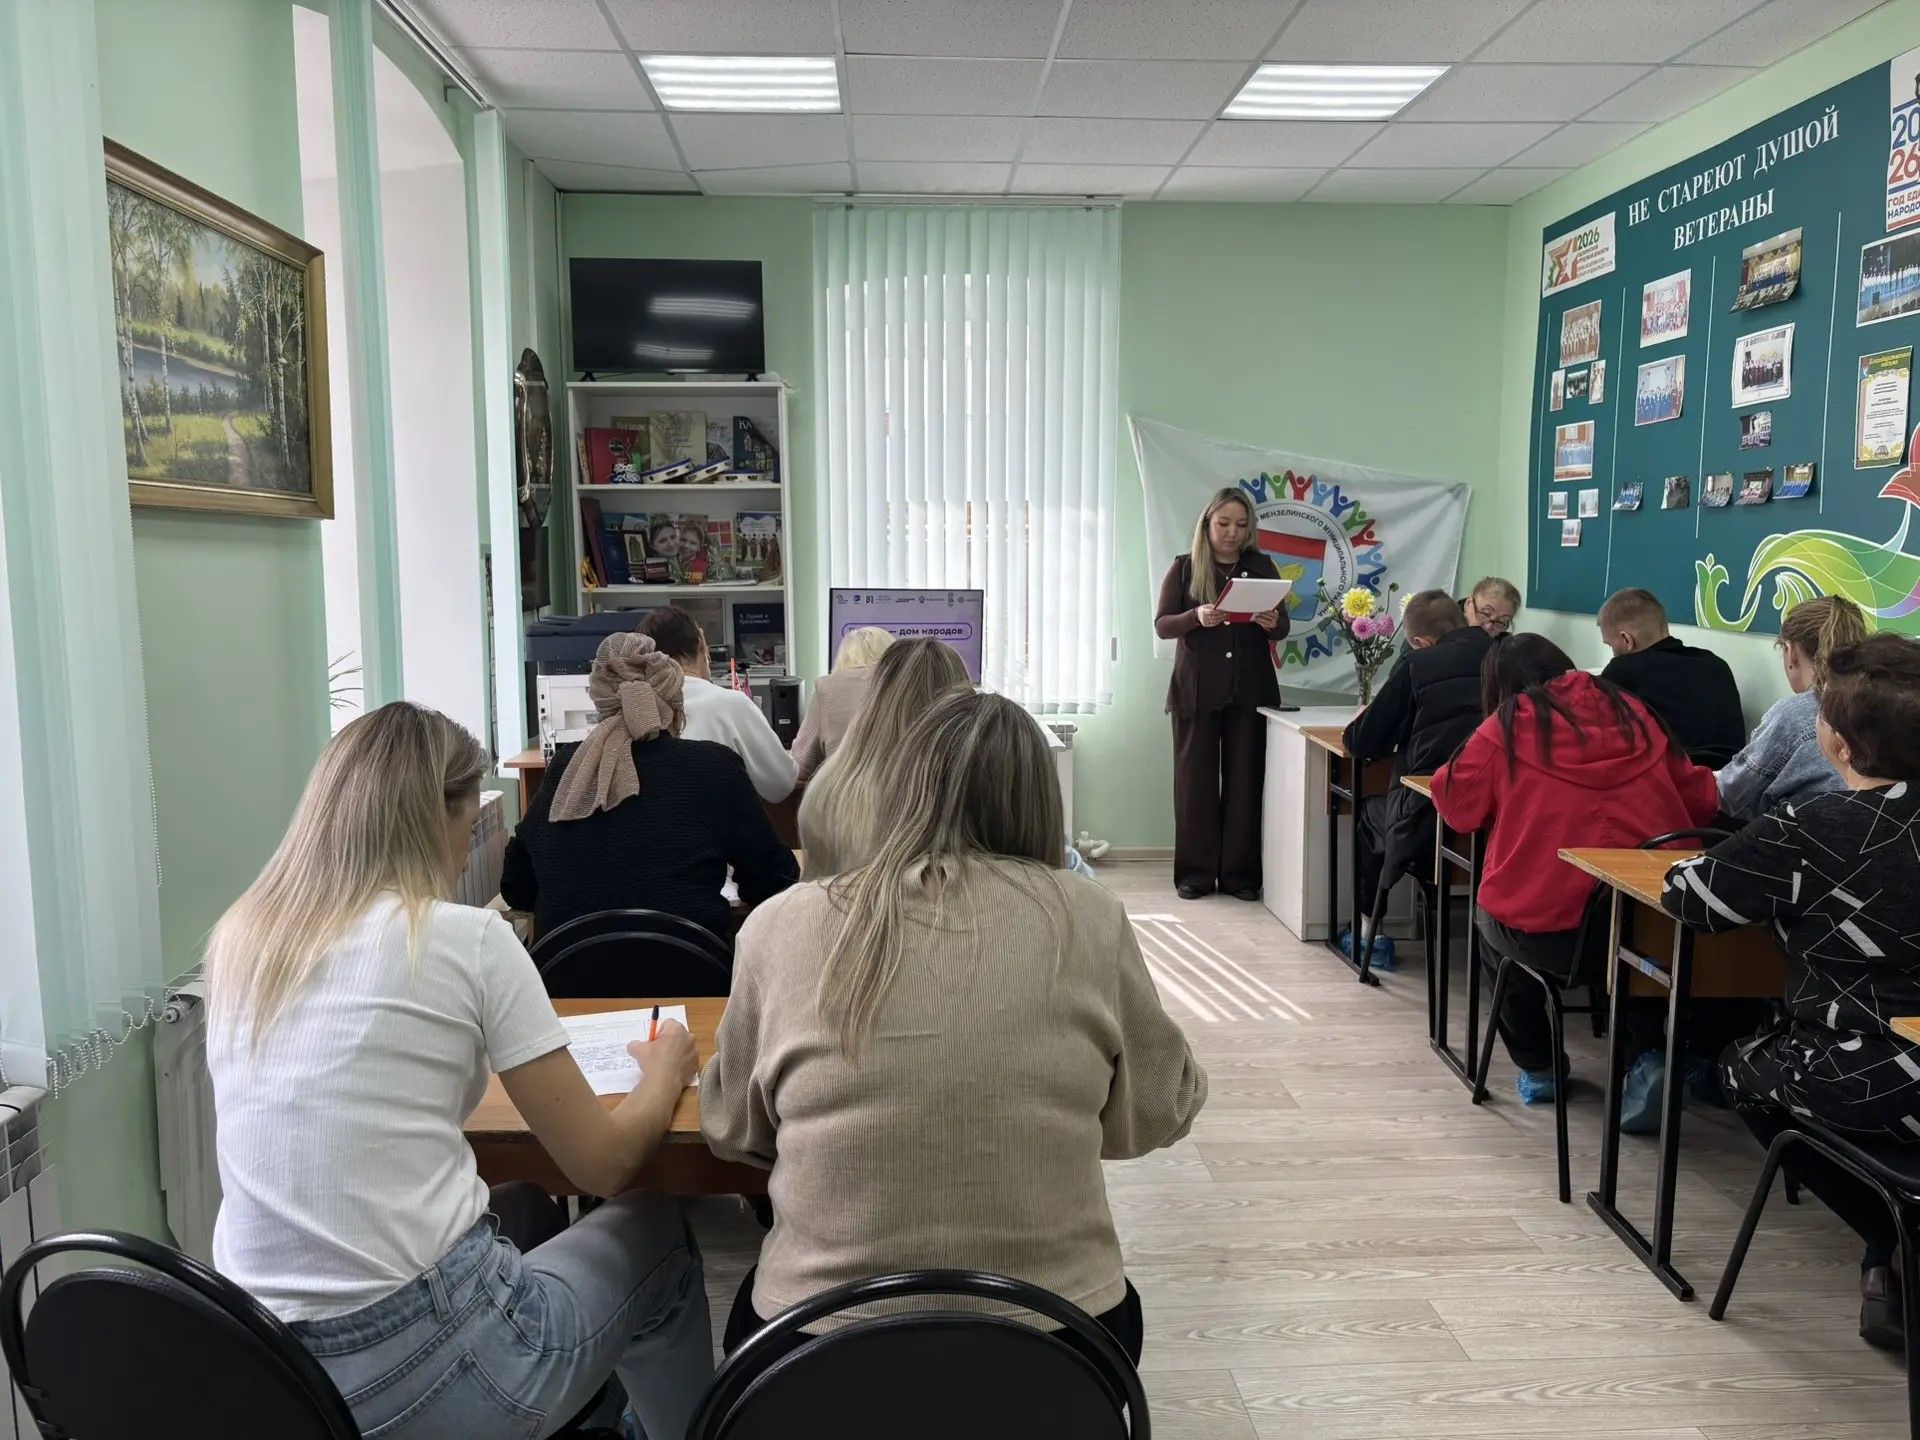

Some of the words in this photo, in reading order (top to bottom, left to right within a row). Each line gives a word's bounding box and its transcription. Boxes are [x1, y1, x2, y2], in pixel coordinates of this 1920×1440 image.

[1892, 106, 1920, 150] 20
[1628, 197, 1650, 226] НЕ
[1657, 153, 1746, 213] СТАРЕЮТ
[1753, 104, 1839, 179] ДУШОЙ
[1888, 142, 1920, 184] 26
[1673, 188, 1775, 250] ВЕТЕРАНЫ
[1888, 195, 1905, 208] ГОД
[1577, 227, 1600, 250] 2026
[1260, 509, 1324, 528] МЕНЗЕЛИНСКОГО
[1322, 525, 1347, 591] МУНИЦИПАЛЬНОГО
[899, 628, 919, 636] дом
[922, 628, 963, 636] народов
